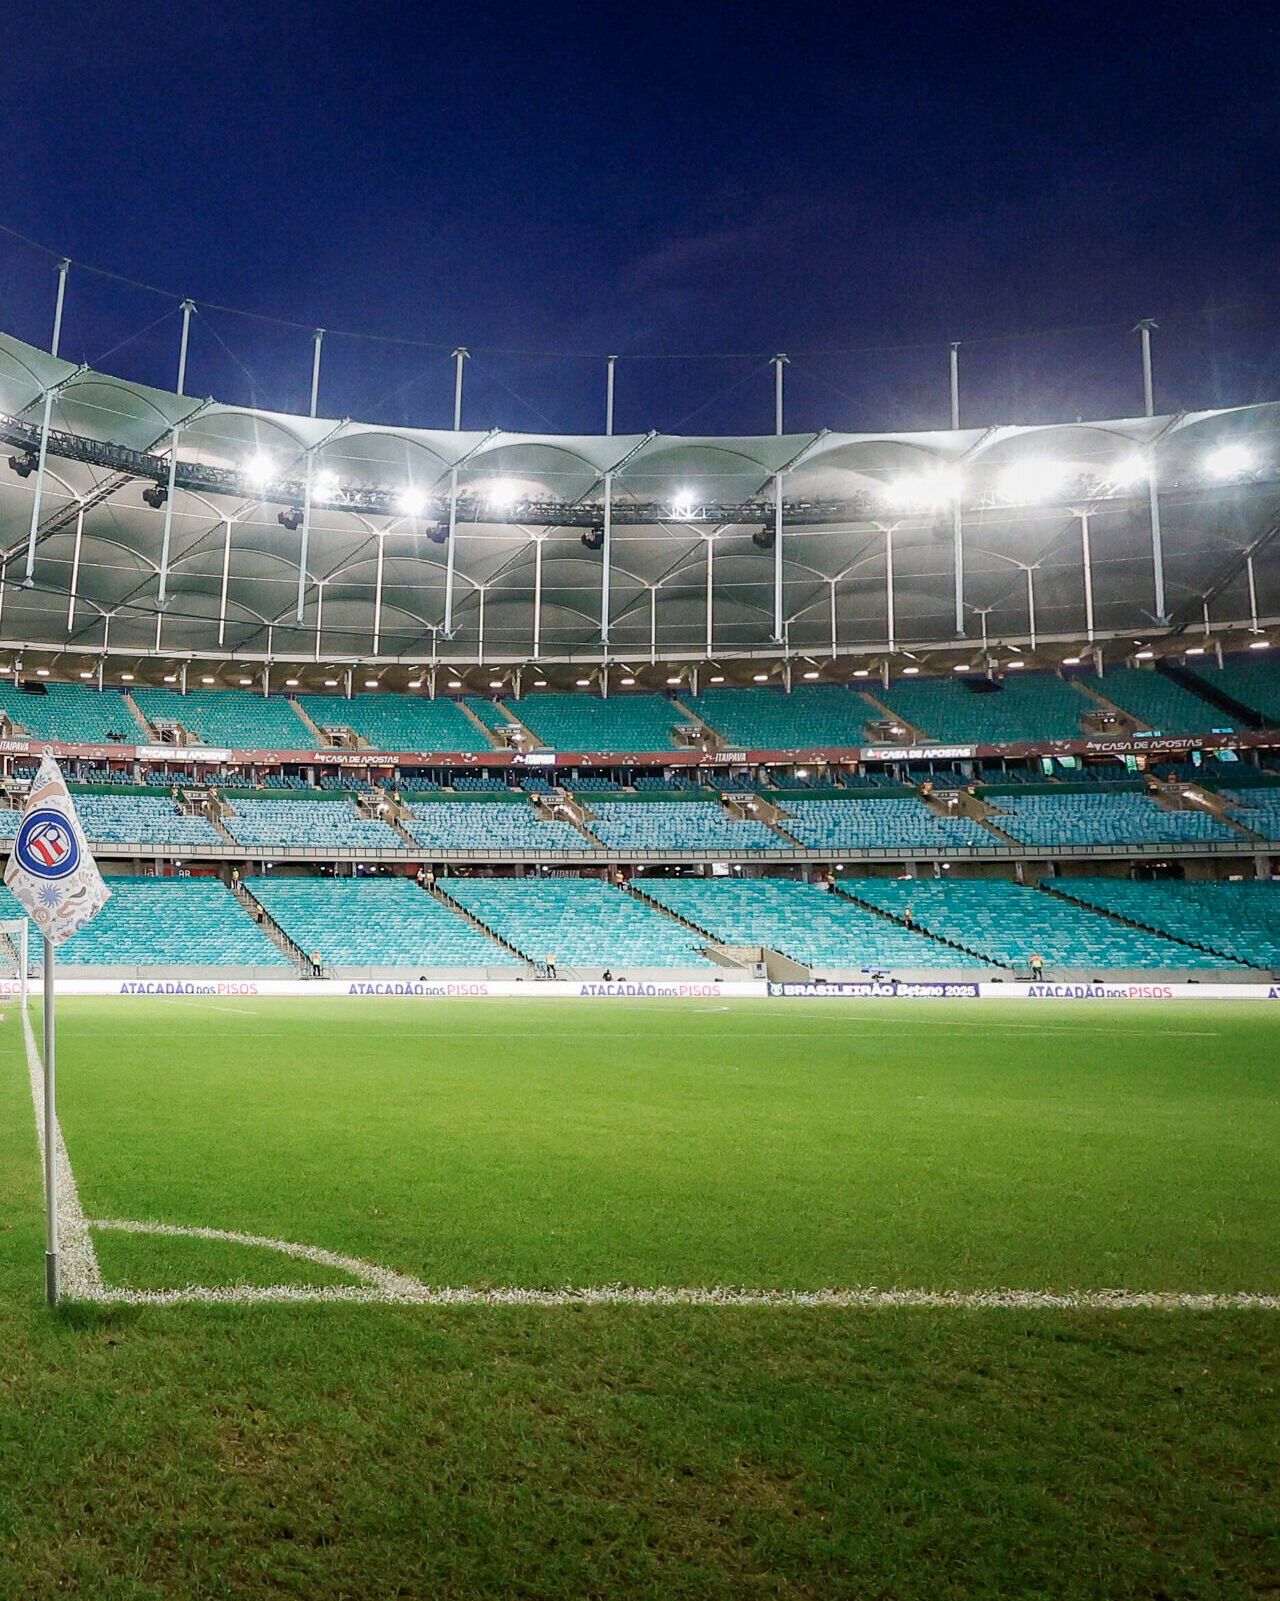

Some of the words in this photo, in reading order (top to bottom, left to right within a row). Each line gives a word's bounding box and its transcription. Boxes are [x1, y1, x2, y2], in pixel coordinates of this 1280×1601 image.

[0, 741, 29, 751] ITAIPAVA
[1101, 741, 1131, 751] CASA
[1134, 741, 1149, 750] DE
[1150, 739, 1203, 749] APOSTAS
[325, 755, 347, 763] CASA
[360, 756, 399, 764] APOSTAS
[715, 752, 746, 763] ITAIPAVA
[880, 750, 907, 760] CASA
[908, 750, 923, 759] DE
[923, 748, 971, 759] APOSTAS
[120, 981, 195, 994] ATACADÃO
[217, 983, 259, 994] PISOS
[349, 982, 424, 995] ATACADÃO
[447, 984, 489, 995] PISOS
[580, 983, 656, 996] ATACADÃO
[679, 985, 721, 996] PISOS
[784, 983, 894, 997] BRASILEIRÃO
[896, 984, 944, 997] Betano
[945, 985, 976, 996] 2025
[1028, 984, 1105, 998] ATACADÃO
[1129, 986, 1173, 998] PISOS
